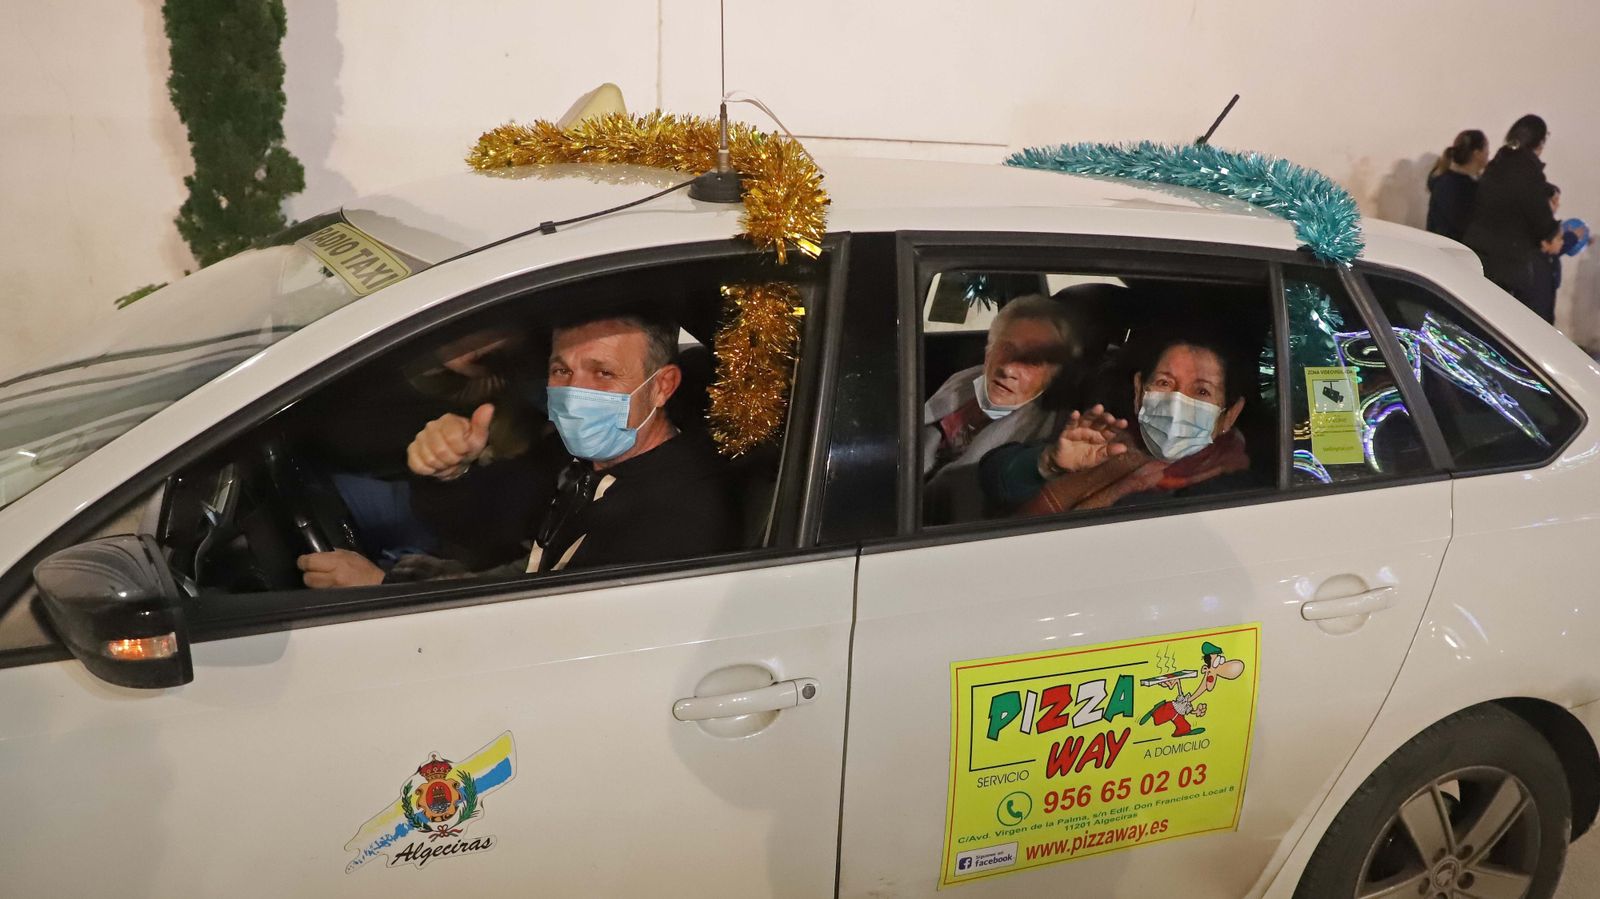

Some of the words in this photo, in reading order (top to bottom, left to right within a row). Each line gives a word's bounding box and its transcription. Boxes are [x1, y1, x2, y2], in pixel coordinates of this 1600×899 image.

[306, 227, 360, 256] RADIO
[341, 248, 399, 290] TAXI
[987, 674, 1134, 741] PIZZA
[1046, 727, 1131, 779] WAY
[1143, 748, 1152, 760] A
[1154, 738, 1210, 758] DOMICILIO
[977, 769, 1030, 789] SERVICIO
[1043, 784, 1092, 814] 956
[1100, 777, 1132, 803] 65
[1140, 770, 1170, 796] 02
[1178, 763, 1207, 788] 03
[958, 833, 991, 844] C/Avd.
[995, 827, 1028, 837] Virgen
[1030, 823, 1043, 831] de
[1045, 819, 1055, 828] la
[1057, 815, 1090, 826] Palma,
[1092, 810, 1107, 819] s/n
[1109, 805, 1131, 815] Edif.
[1133, 802, 1153, 811] Don
[1155, 792, 1200, 807] Francisco
[1202, 787, 1227, 797] Local
[1064, 820, 1091, 832] 11201
[1094, 812, 1138, 826] Algeciras
[391, 836, 492, 866] Algeciras
[975, 853, 1013, 867] facebook
[1025, 818, 1169, 861] www.pizzaway.es
